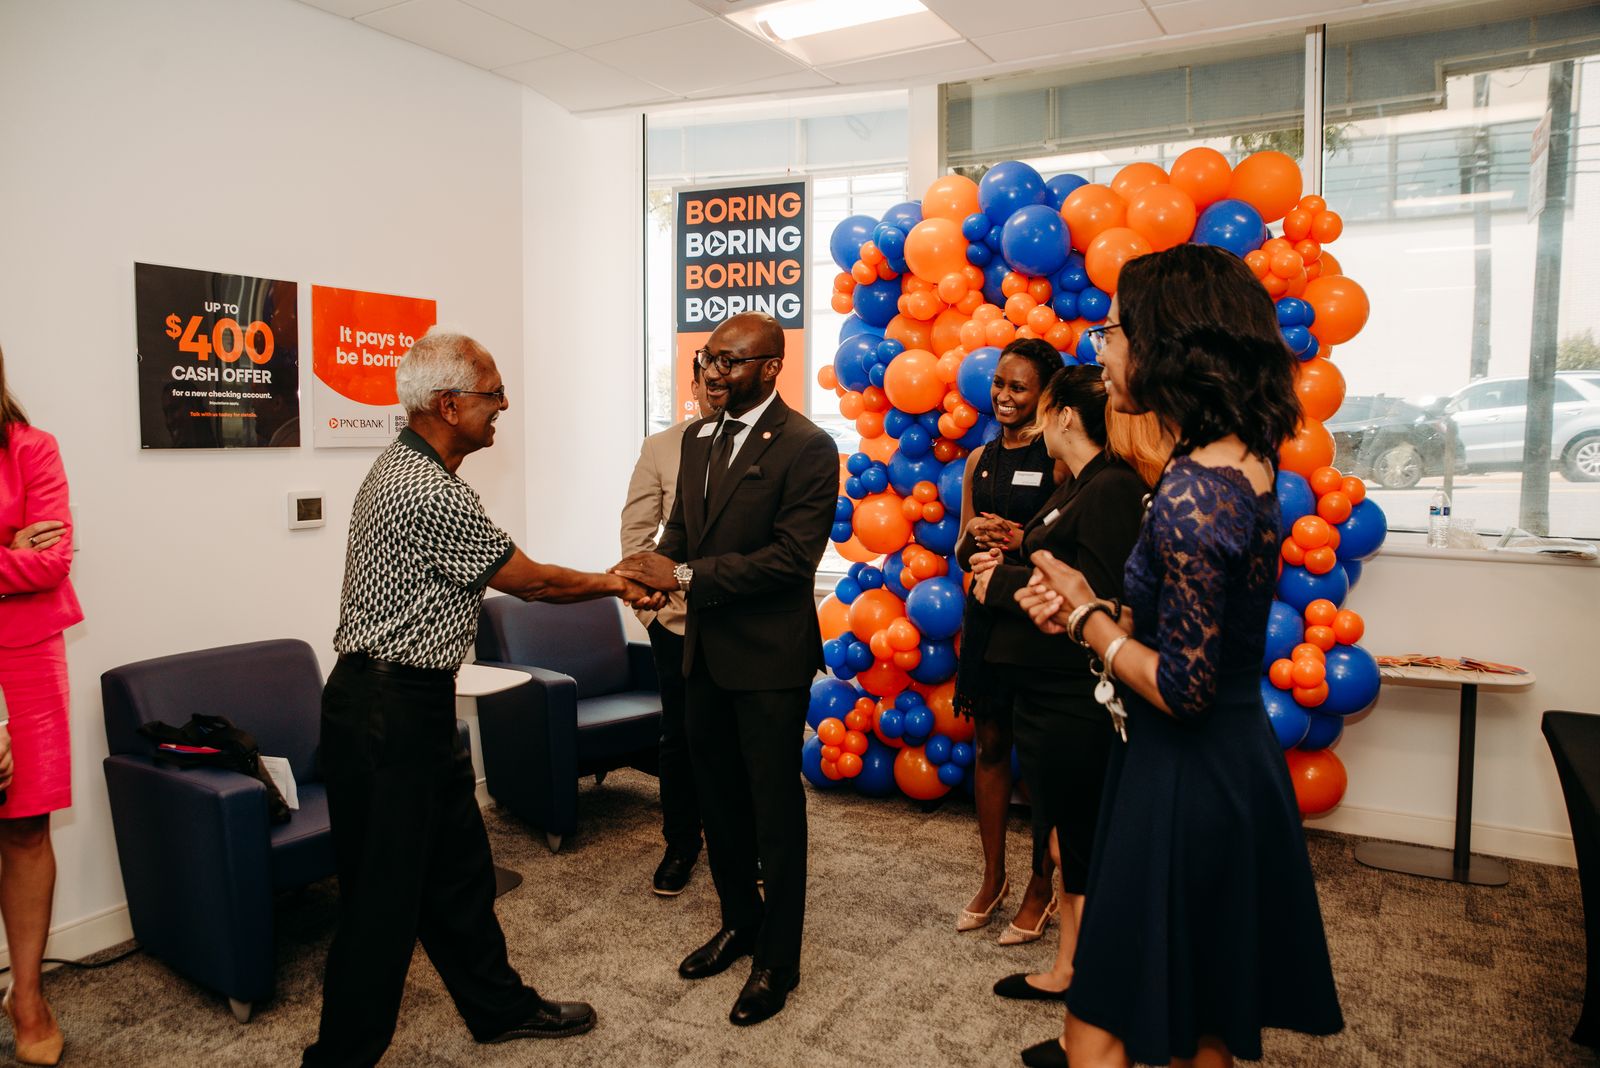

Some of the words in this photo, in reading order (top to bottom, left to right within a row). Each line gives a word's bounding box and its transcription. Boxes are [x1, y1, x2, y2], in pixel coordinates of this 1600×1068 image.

[685, 191, 802, 225] BORING
[685, 225, 802, 258] BORING
[685, 259, 801, 290] BORING
[204, 301, 221, 313] UP
[223, 303, 239, 315] TO
[685, 292, 801, 323] BORING
[165, 313, 275, 365] $400
[340, 325, 352, 343] It
[356, 331, 395, 350] pays
[399, 332, 415, 348] to
[336, 346, 359, 365] be
[362, 348, 402, 368] borin
[171, 365, 219, 382] CASH
[222, 368, 272, 384] OFFER
[172, 388, 184, 397] for
[208, 390, 242, 399] checking
[340, 418, 359, 428] PNC
[360, 419, 384, 428] BANK
